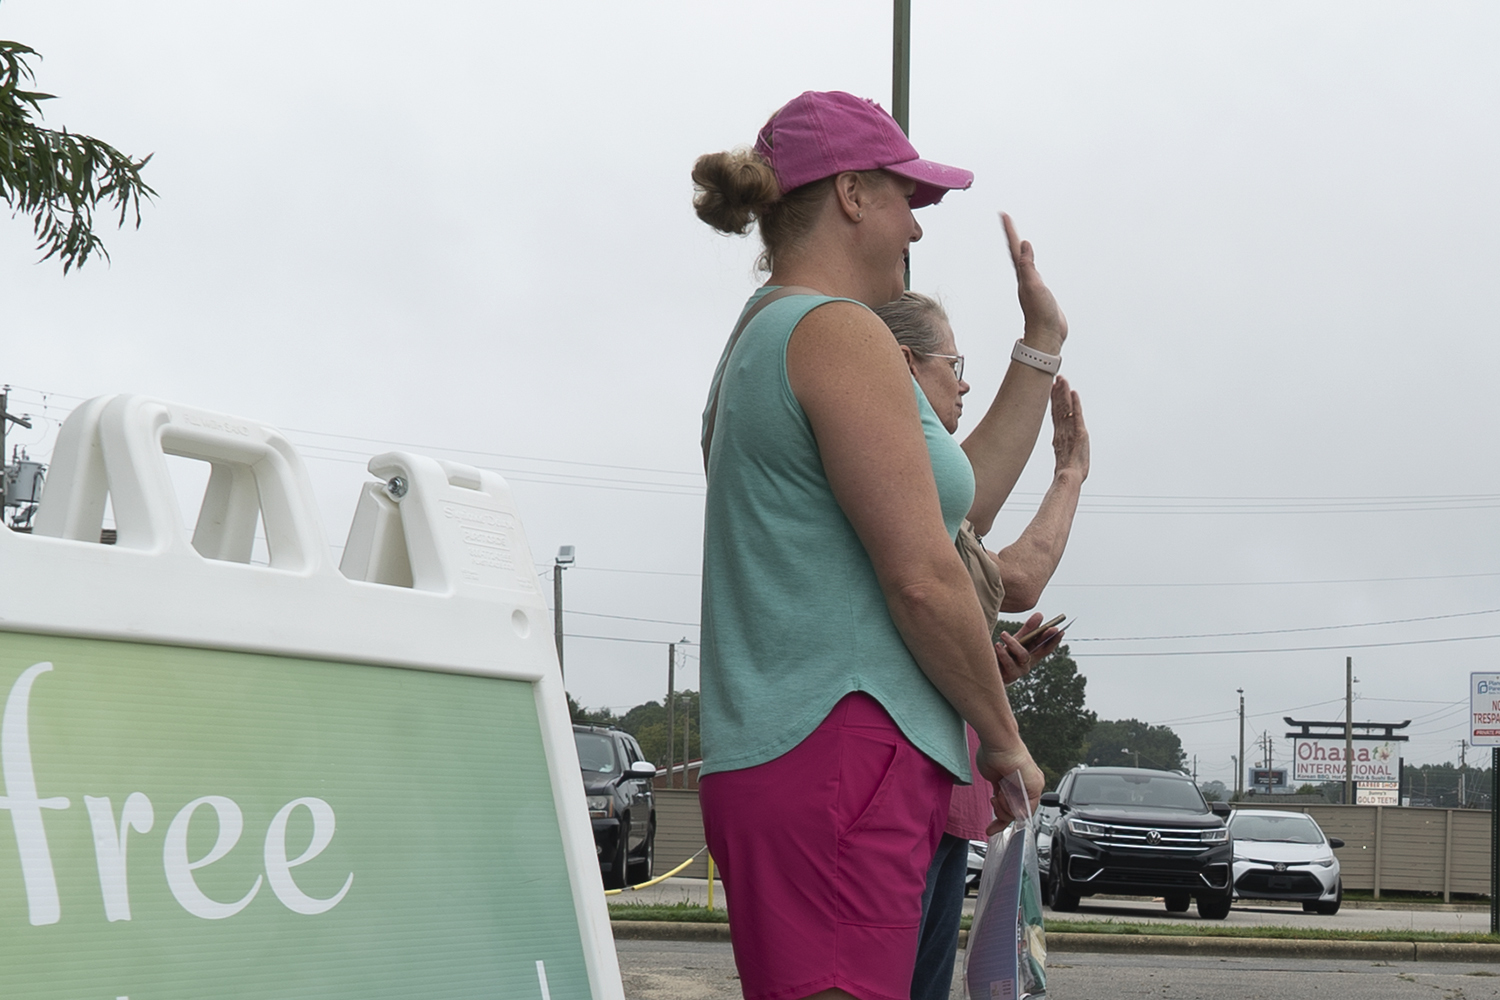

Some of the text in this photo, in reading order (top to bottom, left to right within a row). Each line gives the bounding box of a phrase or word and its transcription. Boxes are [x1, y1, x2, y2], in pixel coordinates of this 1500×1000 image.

[1298, 742, 1371, 762] Ohana
[0, 661, 354, 926] free
[1357, 796, 1376, 804] GOLD
